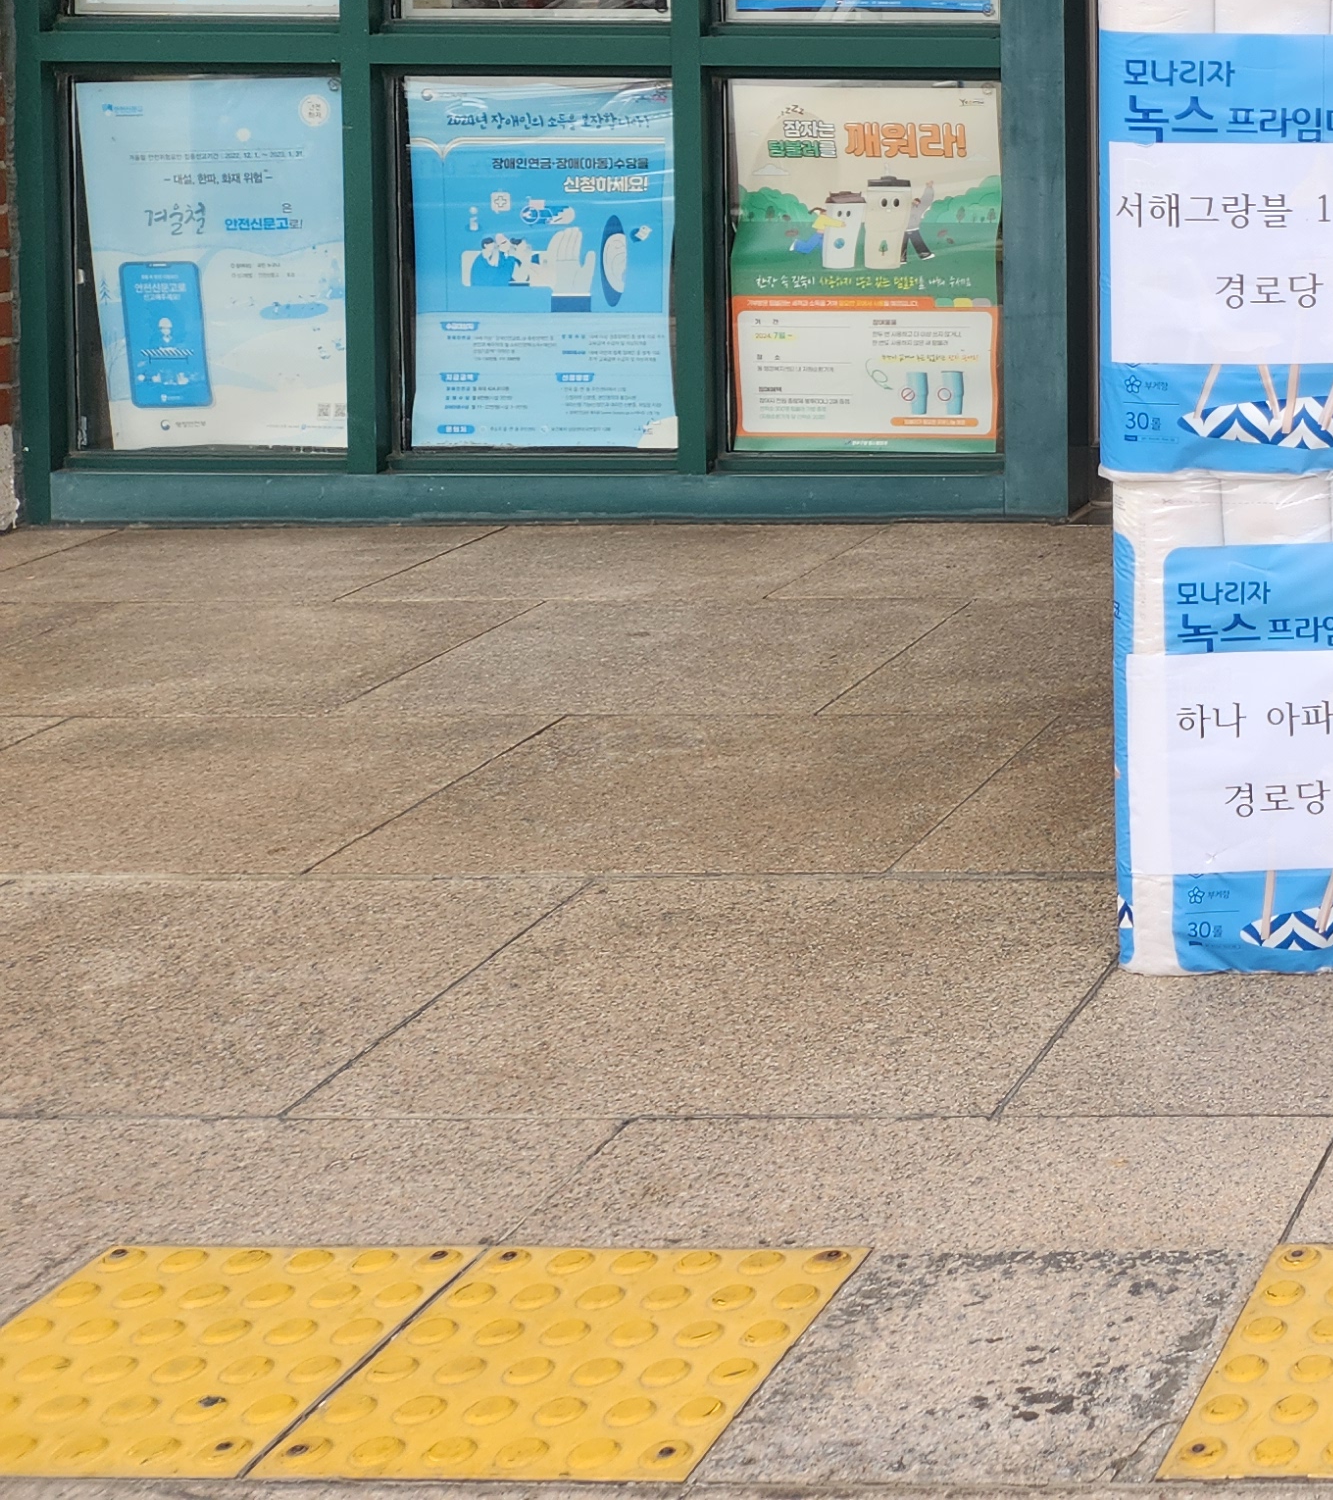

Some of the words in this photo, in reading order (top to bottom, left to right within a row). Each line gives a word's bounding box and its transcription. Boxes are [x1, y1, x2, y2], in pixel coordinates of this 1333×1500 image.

[1123, 59, 1235, 88] 모나리자
[1123, 95, 1220, 144] 녹스
[768, 140, 837, 158] 텀블러를
[784, 120, 835, 138] 잠자는
[844, 122, 967, 158] 깨워라!
[222, 173, 240, 184] 화재
[244, 172, 263, 183] 위험
[563, 176, 648, 192] 신청하세요!
[144, 202, 206, 235] 겨울철
[1115, 192, 1295, 230] 서해그랑블
[1215, 272, 1324, 310] 경로당
[1175, 701, 1247, 740] 하나
[1224, 780, 1332, 819] 경로당
